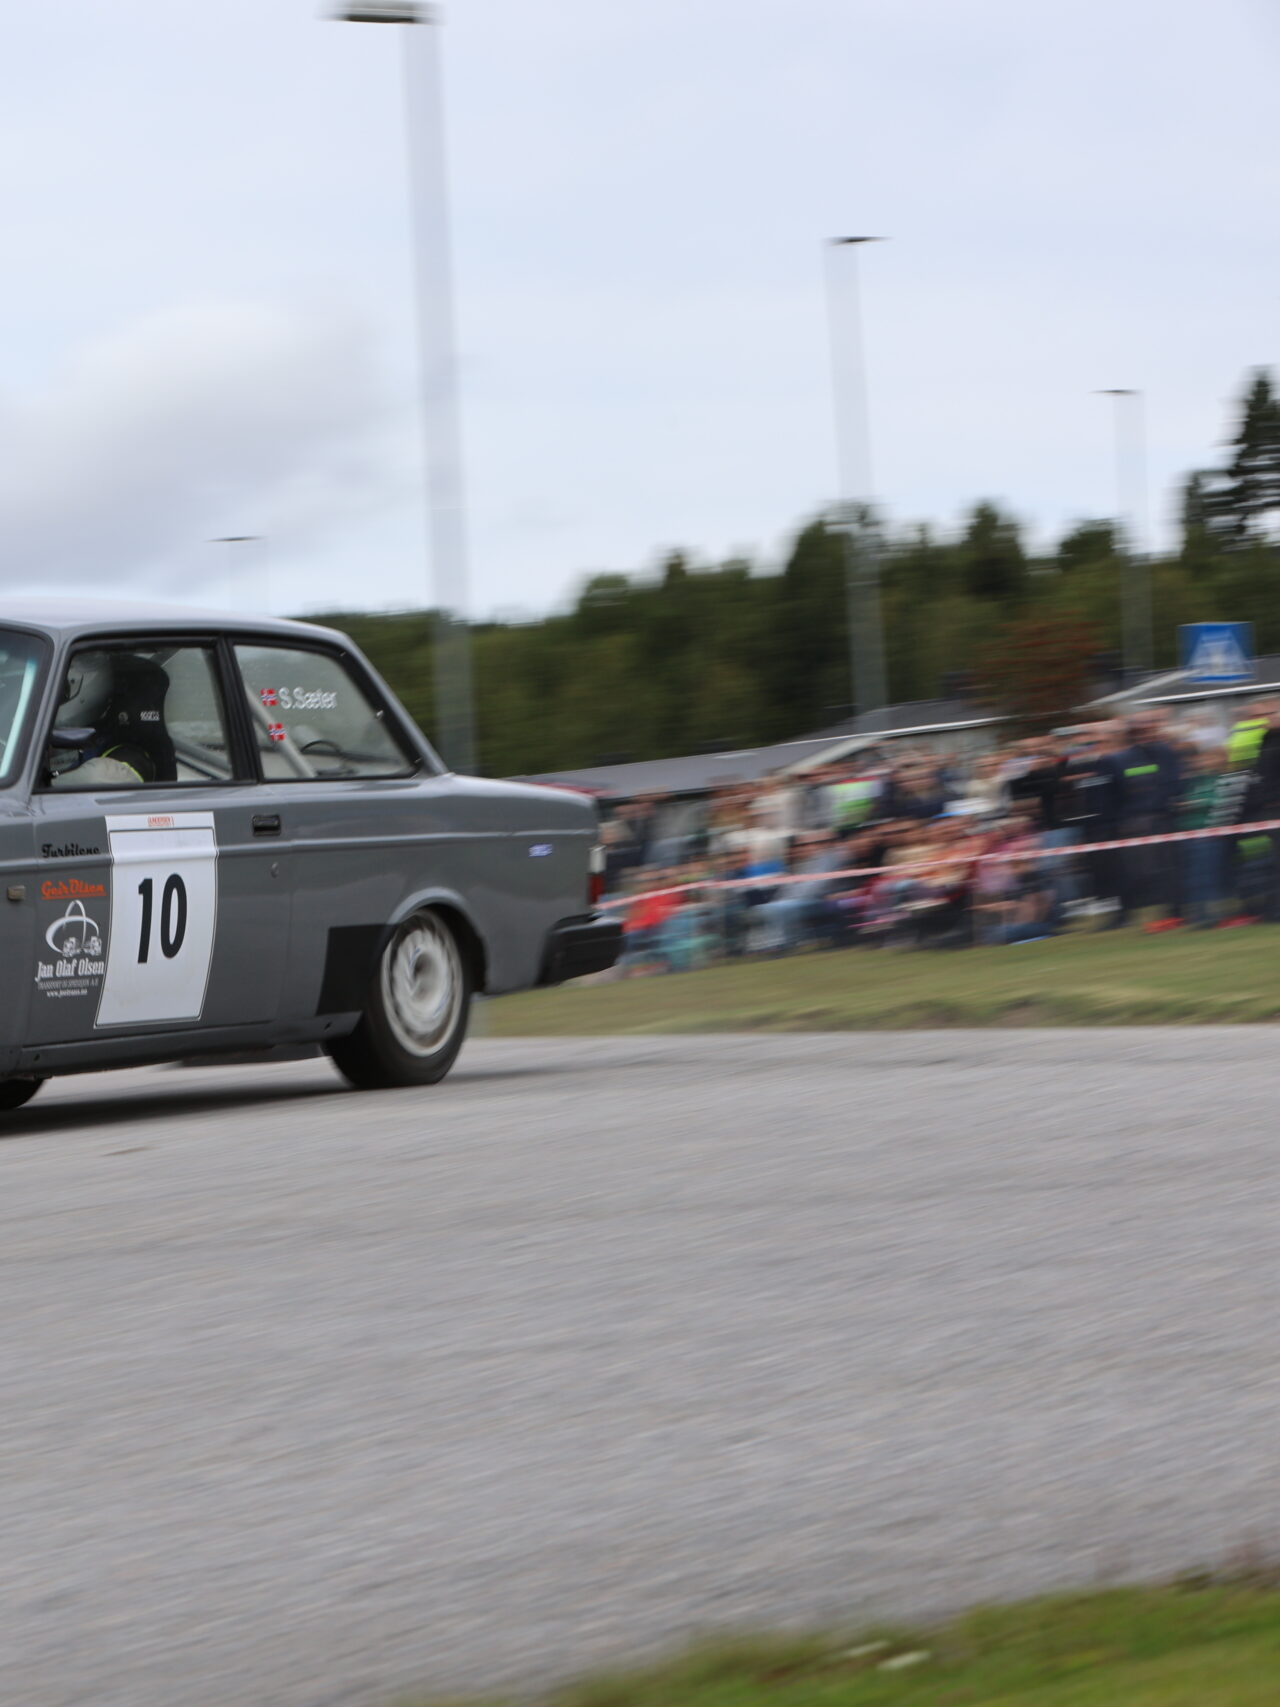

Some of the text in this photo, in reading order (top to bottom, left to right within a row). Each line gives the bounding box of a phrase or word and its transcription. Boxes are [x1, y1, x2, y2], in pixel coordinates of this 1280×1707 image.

[137, 873, 187, 964] 10
[34, 957, 105, 982] Jan Olaf Olsen
